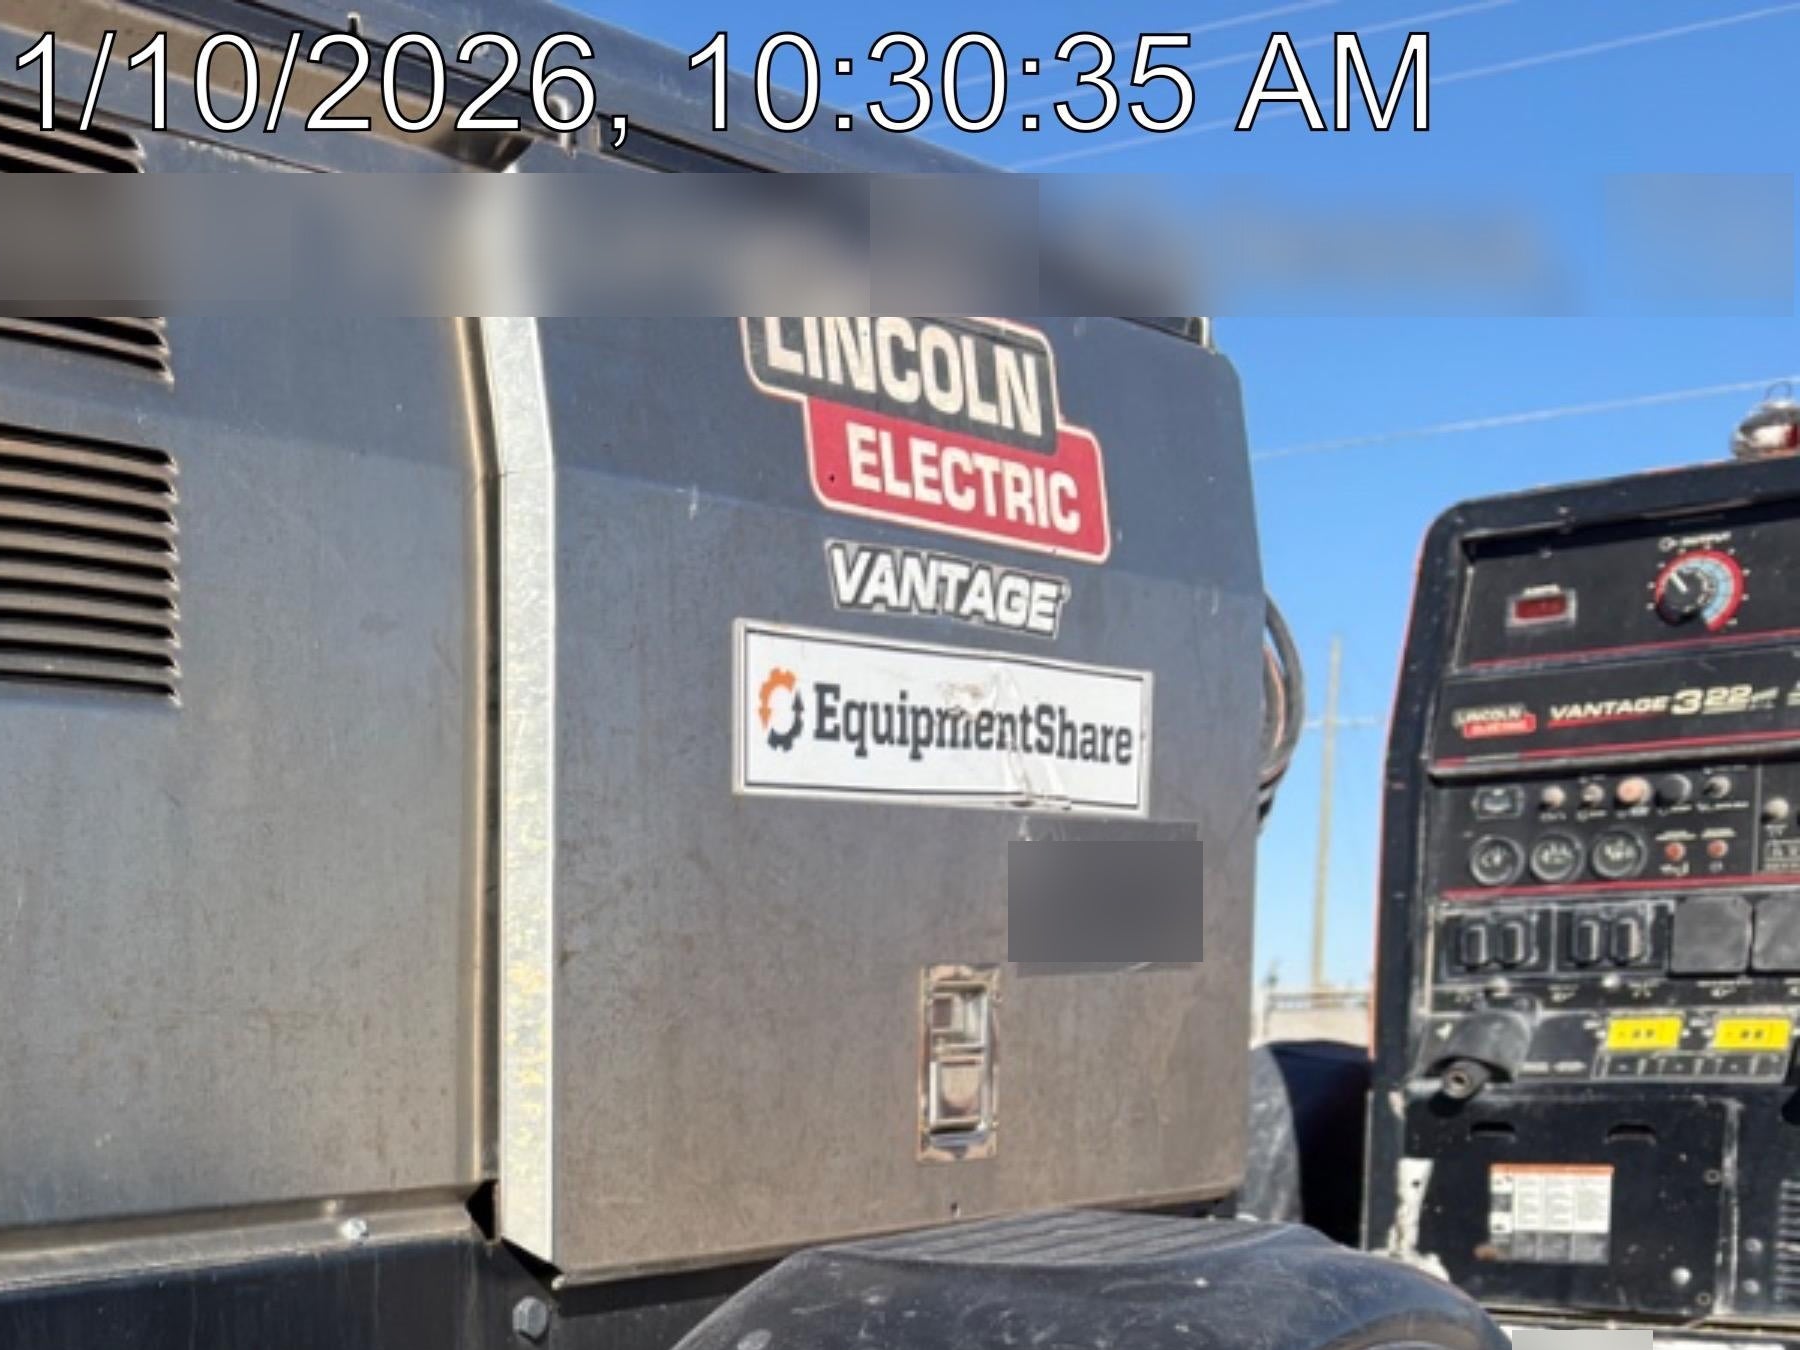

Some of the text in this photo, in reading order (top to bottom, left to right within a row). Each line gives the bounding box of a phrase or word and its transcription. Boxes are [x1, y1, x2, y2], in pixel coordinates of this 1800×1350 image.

[762, 316, 1043, 437] LINCOLN
[845, 421, 1081, 535] ELECTRIC
[829, 544, 1065, 631] VANTAGE
[812, 682, 1132, 766] EquipmentShare
[1549, 684, 1753, 720] VANTAGE 322
